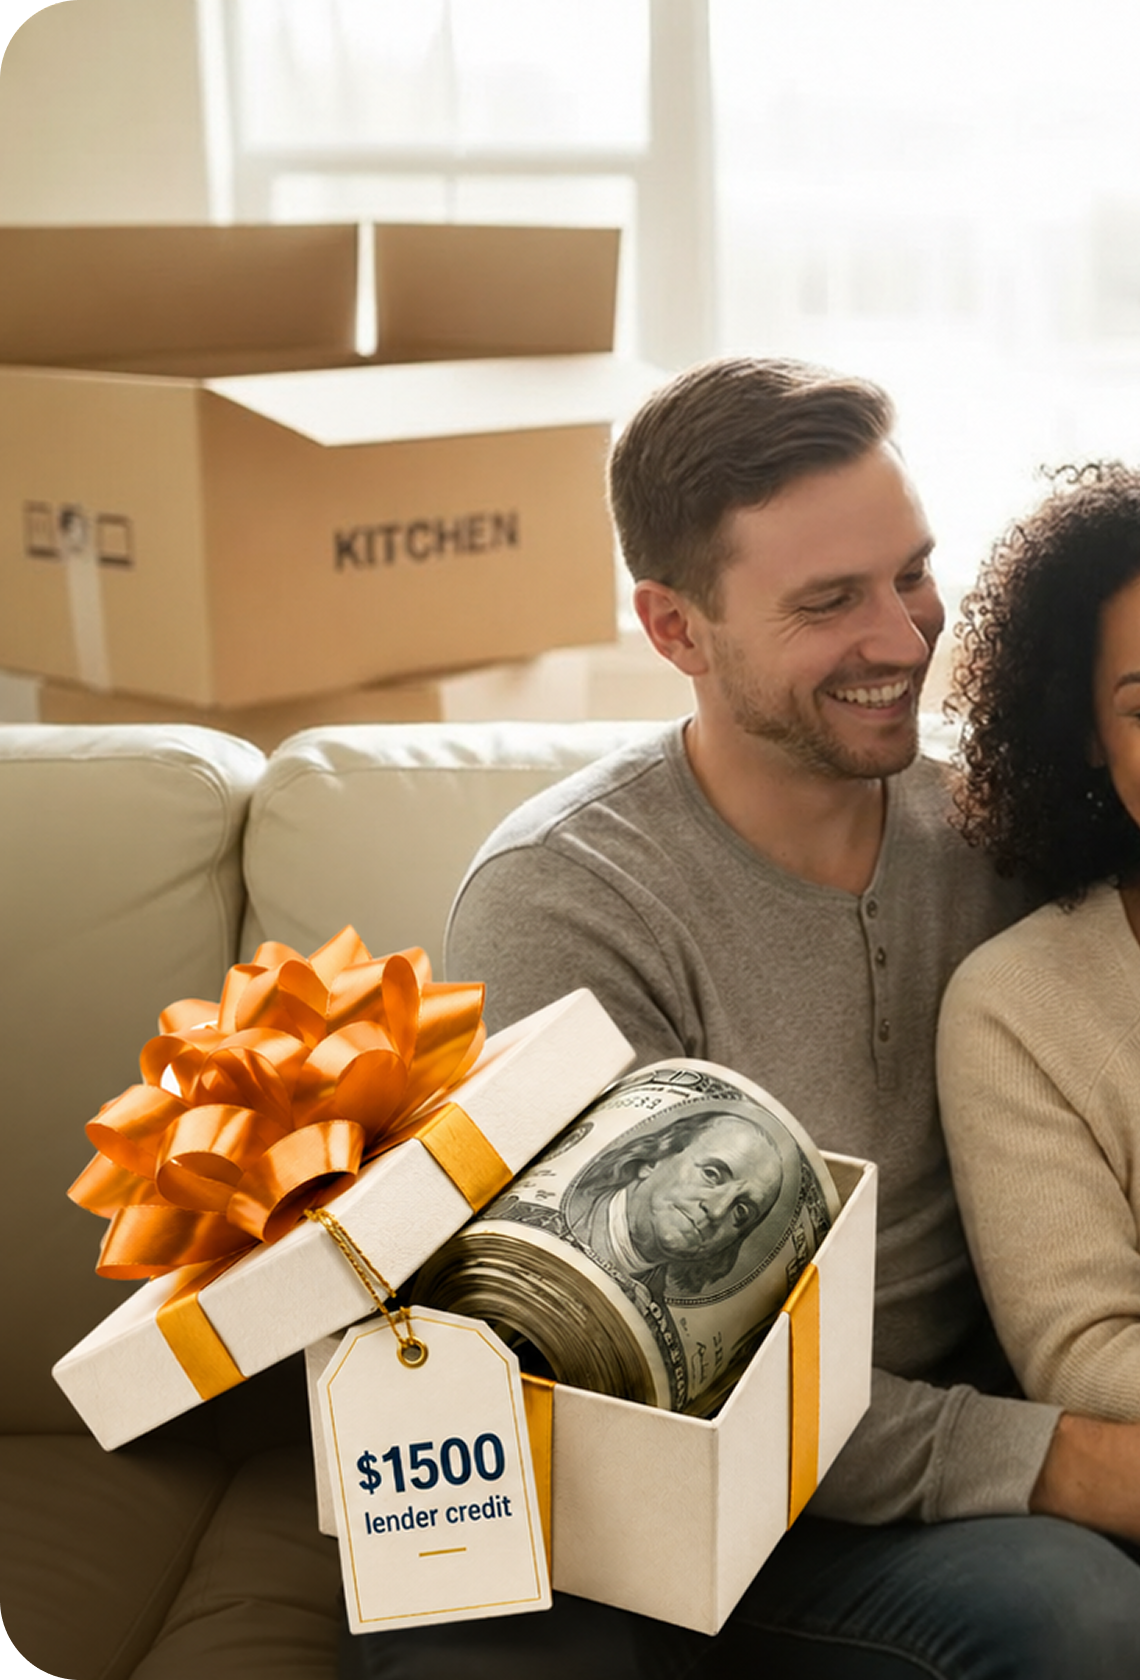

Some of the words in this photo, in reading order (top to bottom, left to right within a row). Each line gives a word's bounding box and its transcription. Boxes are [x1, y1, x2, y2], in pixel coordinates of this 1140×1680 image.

[333, 509, 519, 573] KITCHEN
[357, 1433, 505, 1494] $1500
[365, 1506, 438, 1535] lender
[446, 1495, 513, 1524] credit
